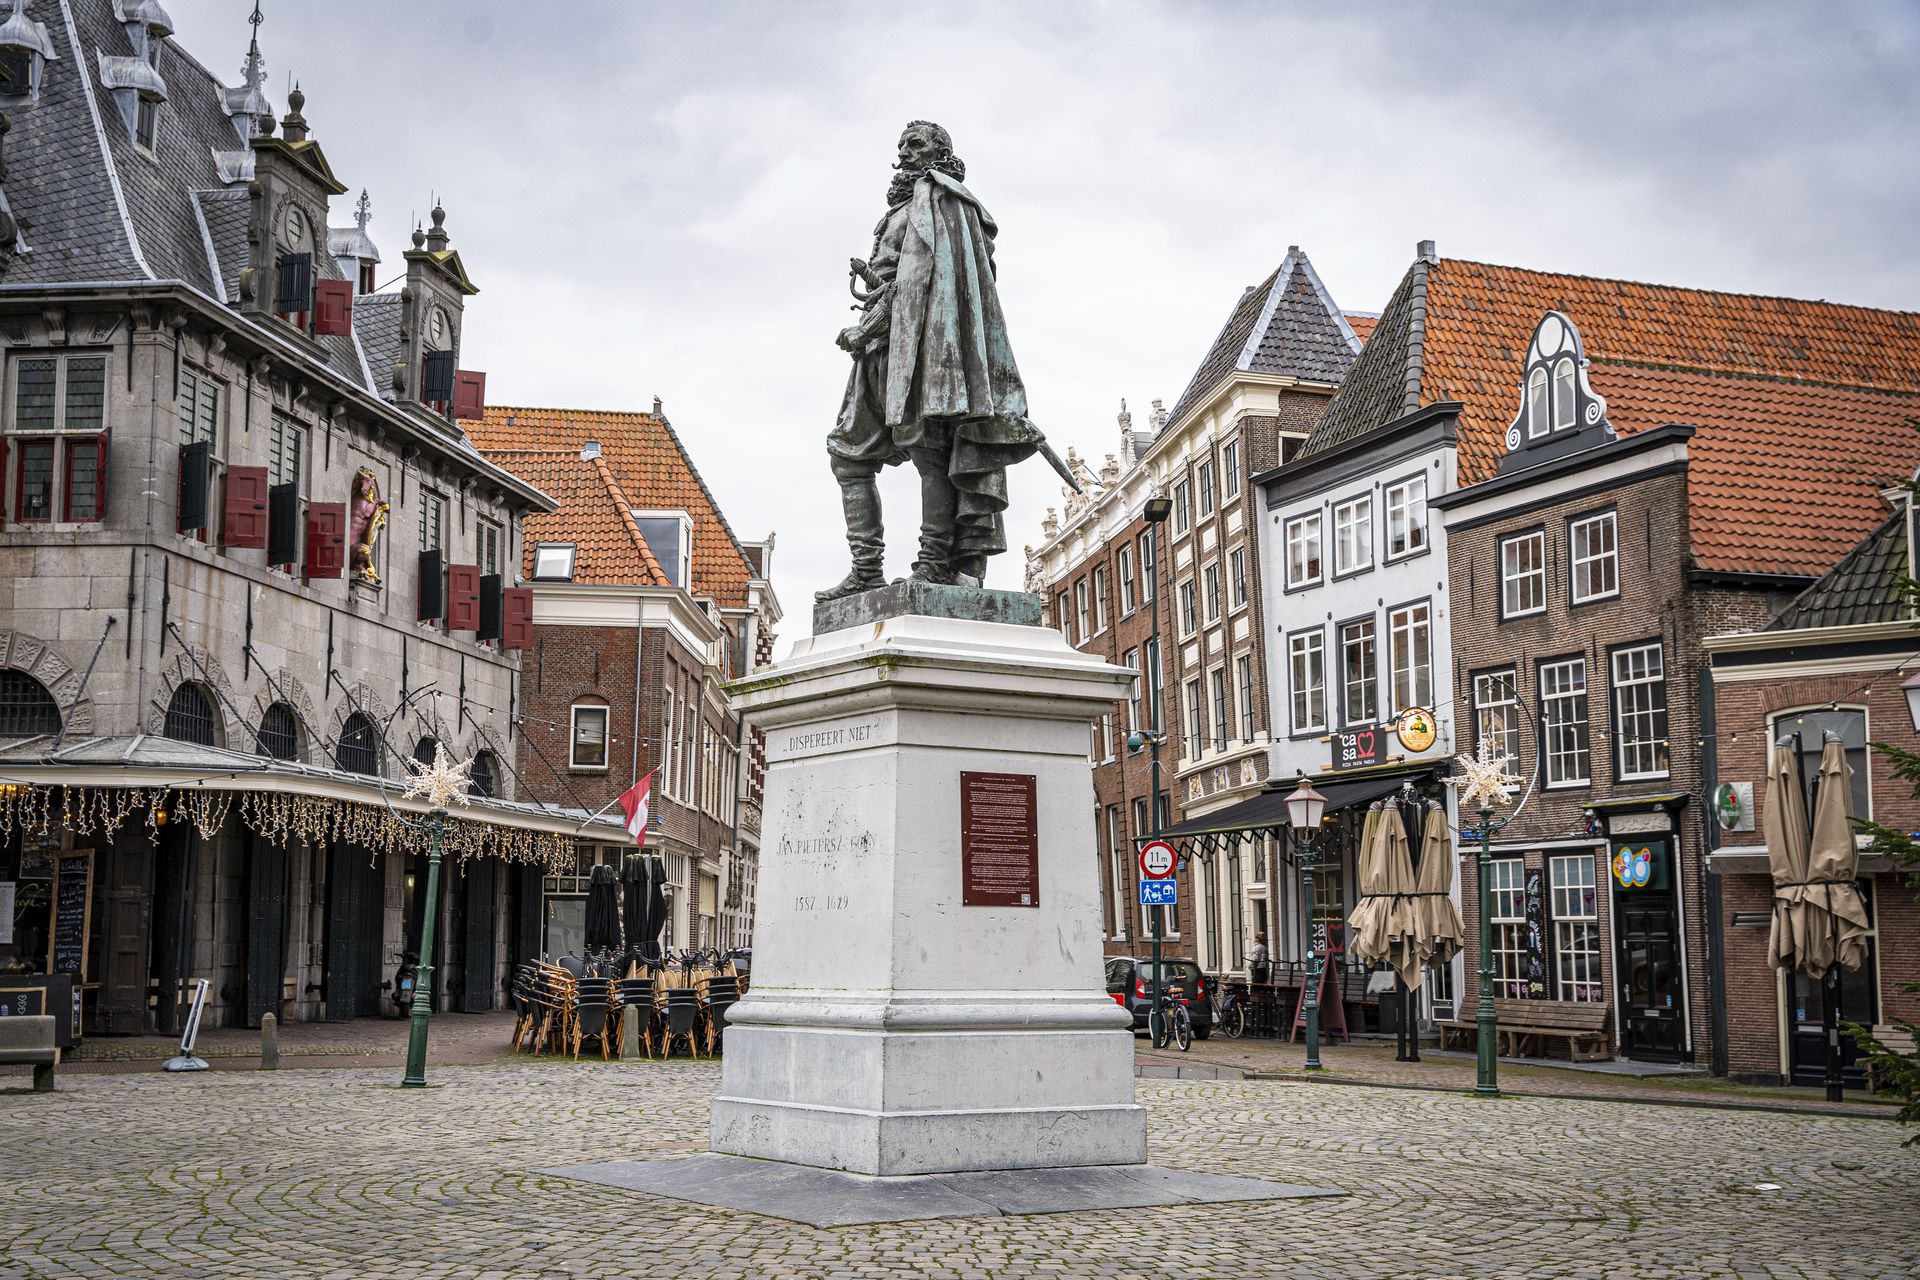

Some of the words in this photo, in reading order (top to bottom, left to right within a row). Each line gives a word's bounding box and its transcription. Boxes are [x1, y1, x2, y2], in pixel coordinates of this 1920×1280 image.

[1341, 733, 1357, 747] ca
[1342, 747, 1357, 761] sa
[1150, 852, 1159, 862] 11
